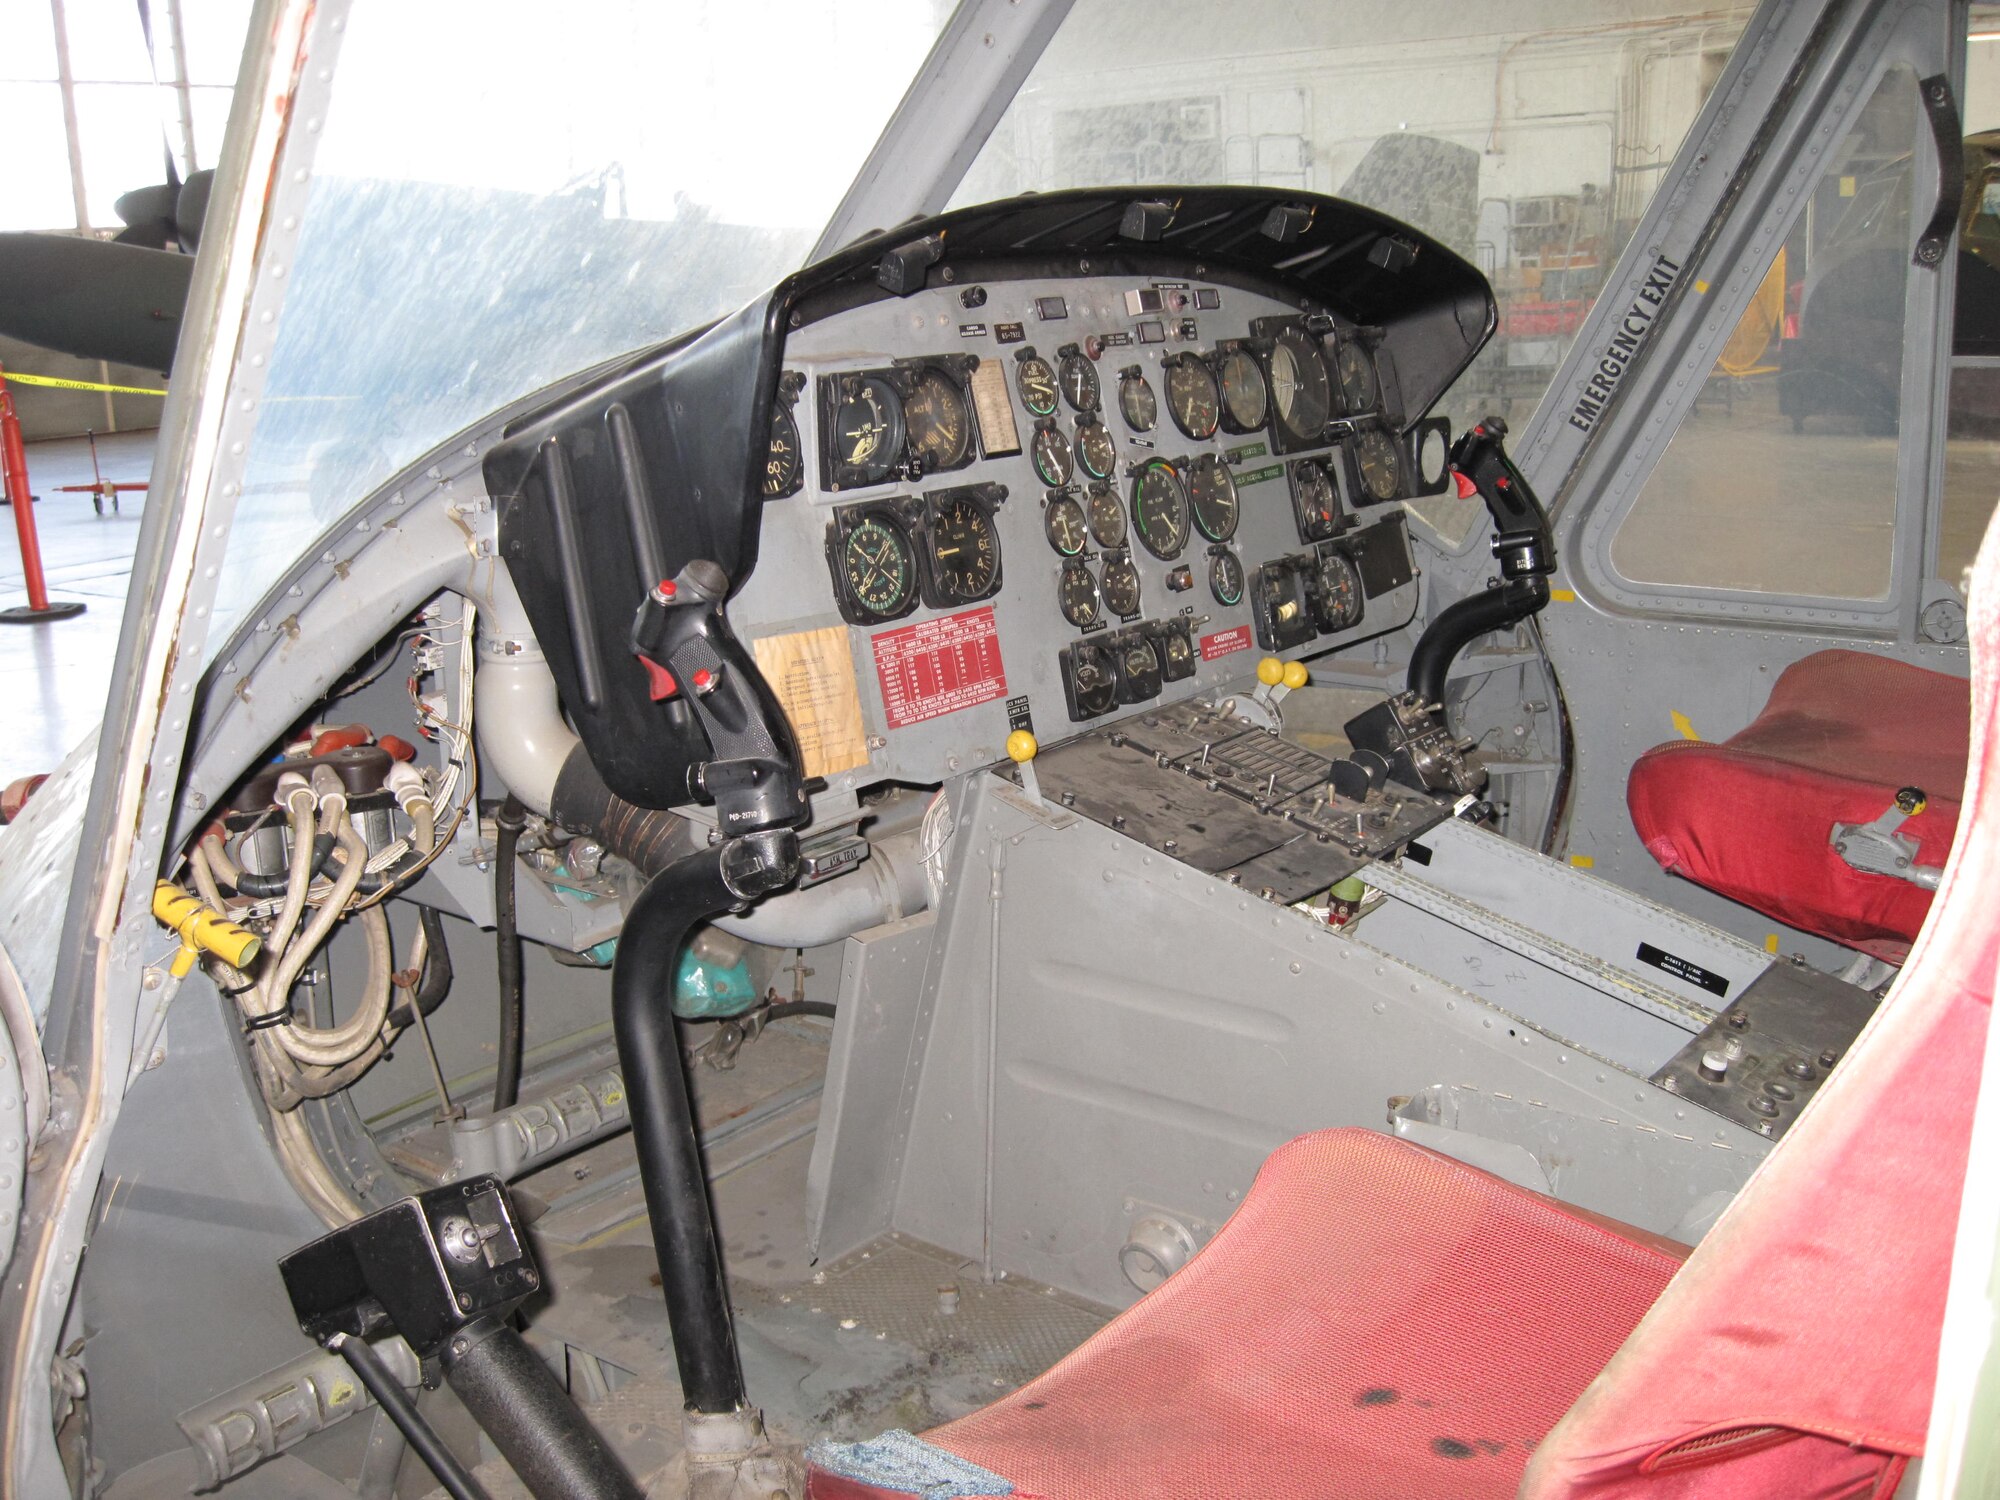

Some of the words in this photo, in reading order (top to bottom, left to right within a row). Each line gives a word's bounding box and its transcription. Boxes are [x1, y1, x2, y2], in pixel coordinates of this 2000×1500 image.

[1568, 303, 1651, 432] EMERGENCY
[1639, 254, 1679, 306] EXIT
[56, 380, 95, 391] CAUTION
[942, 399, 949, 410] 2
[770, 440, 784, 453] 40
[918, 441, 926, 452] 6
[767, 461, 781, 474] 60
[955, 512, 962, 524] 2
[978, 540, 985, 550] 6
[977, 557, 983, 567] 4
[966, 572, 974, 585] 2
[915, 620, 938, 630] OPERATING
[939, 616, 952, 624] LIMITS
[915, 627, 939, 637] CALIBRATED
[939, 622, 958, 631] AIRSPEED
[877, 638, 895, 647] DENSITY
[1213, 631, 1238, 643] CAUTION
[877, 645, 897, 655] ALTITUDE
[892, 705, 905, 713] FROM
[922, 696, 936, 705] KNOTS
[982, 679, 995, 687] RANGE
[893, 710, 906, 719] FROM
[927, 700, 942, 708] KNOTS
[986, 683, 999, 691] RANGE
[899, 715, 916, 725] REDUCE
[924, 709, 936, 718] SPEED
[937, 705, 950, 714] WHEN
[950, 698, 971, 710] VIBRATION
[976, 691, 996, 702] EXCESSIVE
[1661, 962, 1683, 976] CONTROL
[1685, 973, 1701, 984] PANEL
